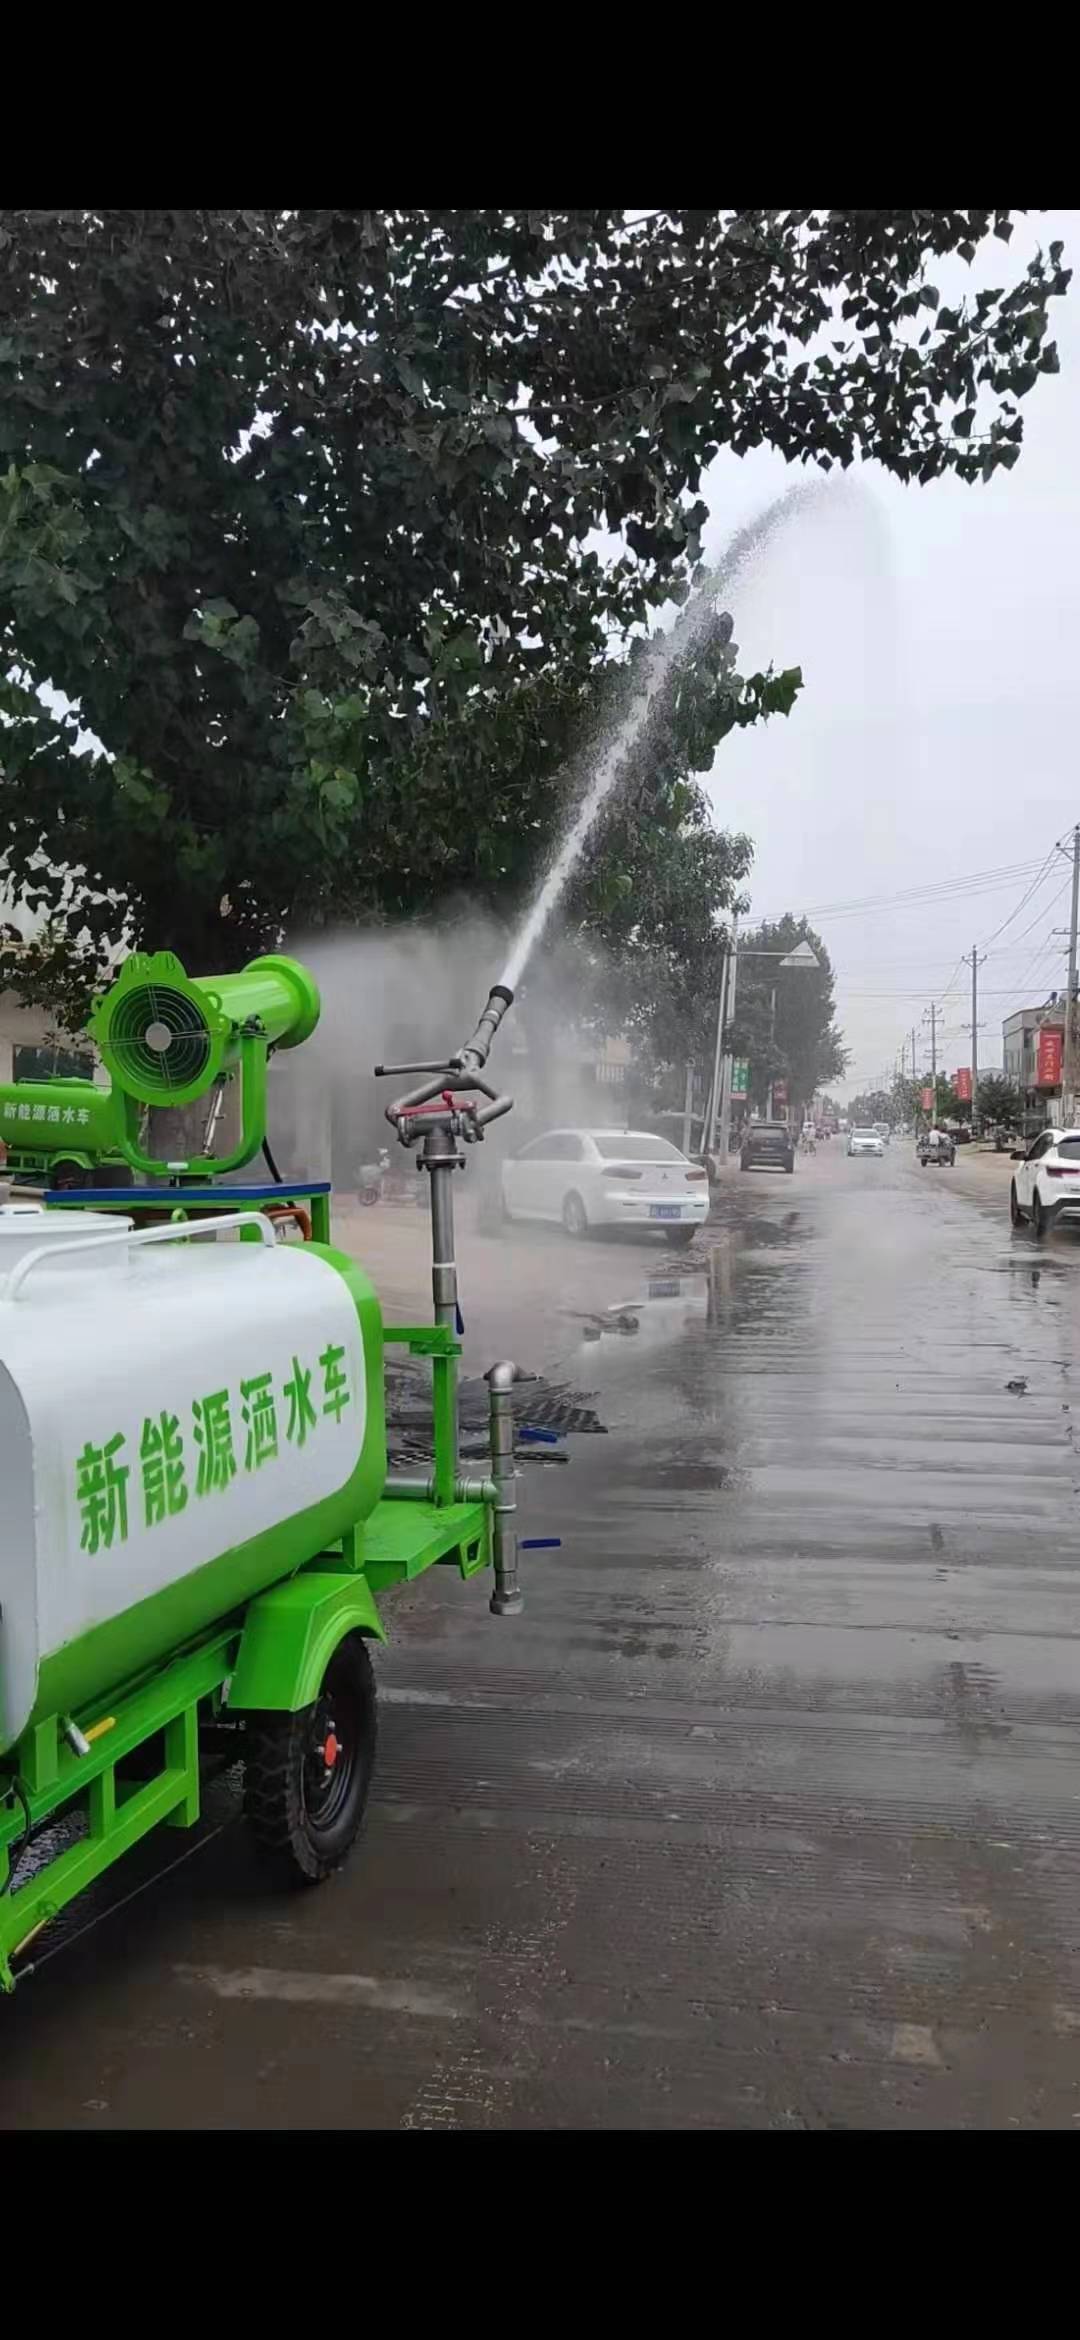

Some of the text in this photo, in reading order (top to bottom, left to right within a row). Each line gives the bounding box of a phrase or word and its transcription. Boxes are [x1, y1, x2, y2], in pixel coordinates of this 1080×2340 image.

[4, 1102, 90, 1125] 新能源洒水车
[76, 1343, 350, 1556] 新能源洒水车
